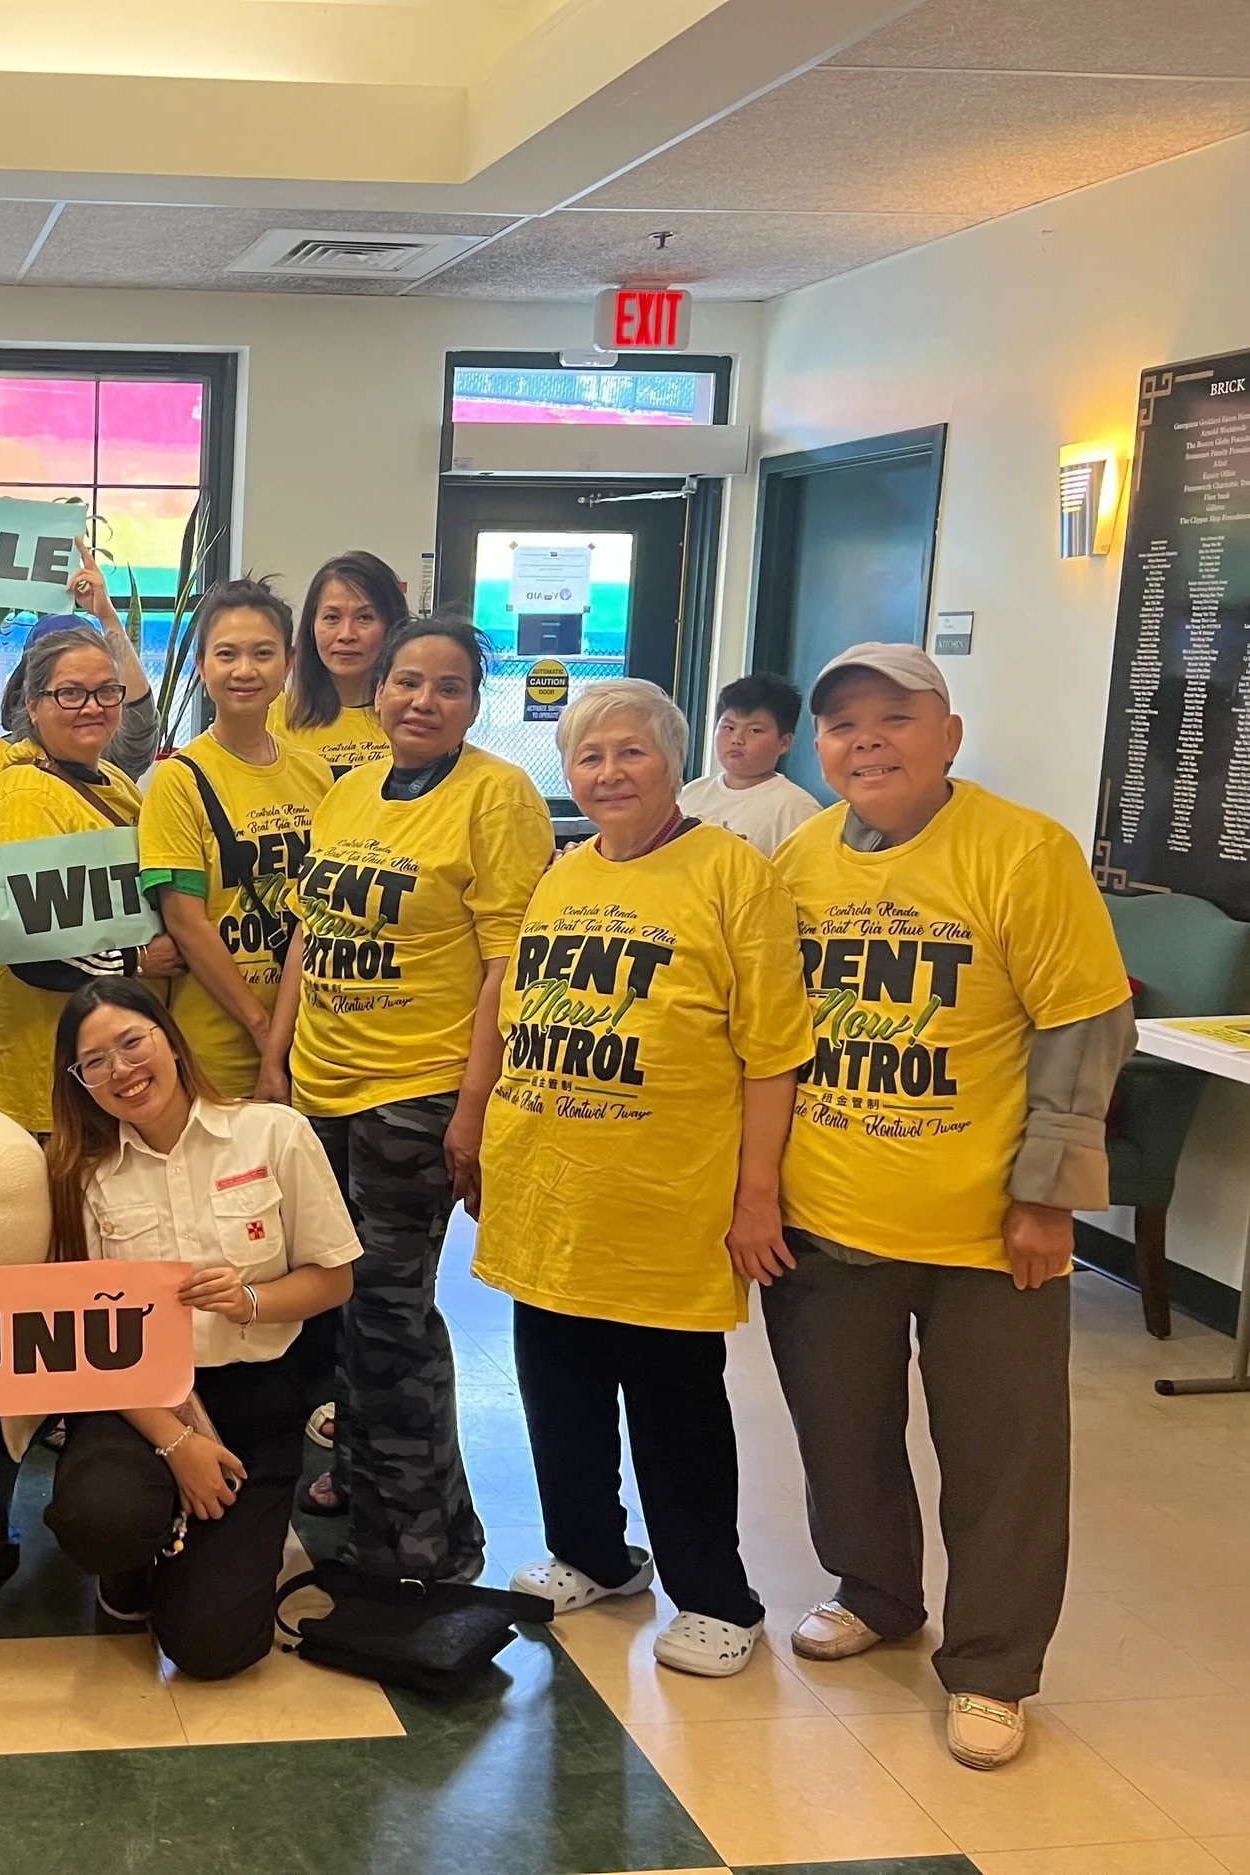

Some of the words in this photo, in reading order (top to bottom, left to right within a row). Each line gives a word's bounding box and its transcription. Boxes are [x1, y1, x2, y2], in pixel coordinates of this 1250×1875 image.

[614, 291, 683, 347] EXIT
[1210, 378, 1246, 396] BRICK
[530, 678, 565, 686] CAUTION
[7, 863, 142, 935] WIT
[825, 901, 871, 917] Controla
[876, 901, 920, 917] Renda
[515, 935, 675, 999] RENT
[520, 978, 638, 1034] Now!
[807, 988, 942, 1048] Now!
[12, 1291, 154, 1376] NỮ
